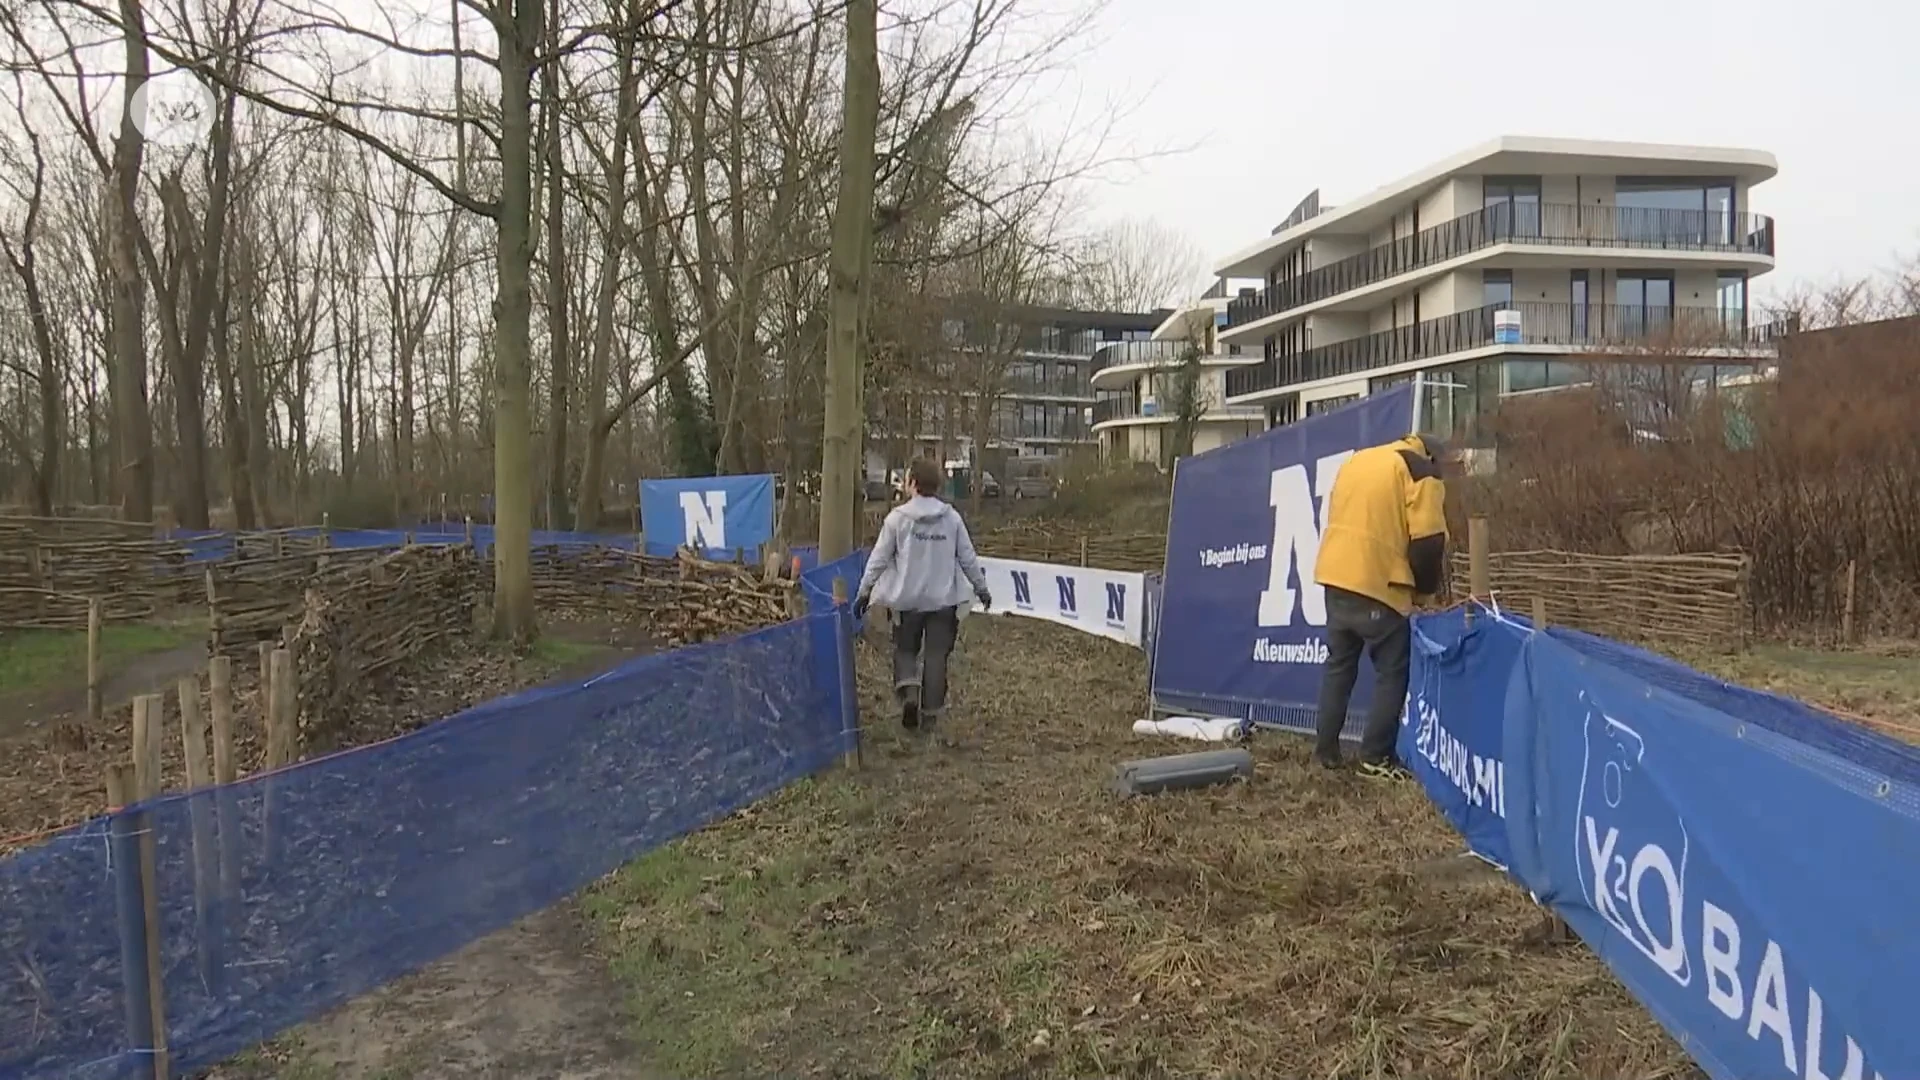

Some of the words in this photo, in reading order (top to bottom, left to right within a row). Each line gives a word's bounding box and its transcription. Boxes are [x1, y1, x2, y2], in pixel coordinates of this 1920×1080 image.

[680, 490, 727, 549] N
[1206, 546, 1235, 568] Begint
[1236, 542, 1249, 565] bij
[1249, 545, 1267, 560] ons
[1258, 450, 1354, 627] N
[1011, 570, 1031, 604] N
[1056, 576, 1076, 612] N
[1105, 582, 1126, 622] N
[1253, 637, 1329, 664] Nieuwsbla
